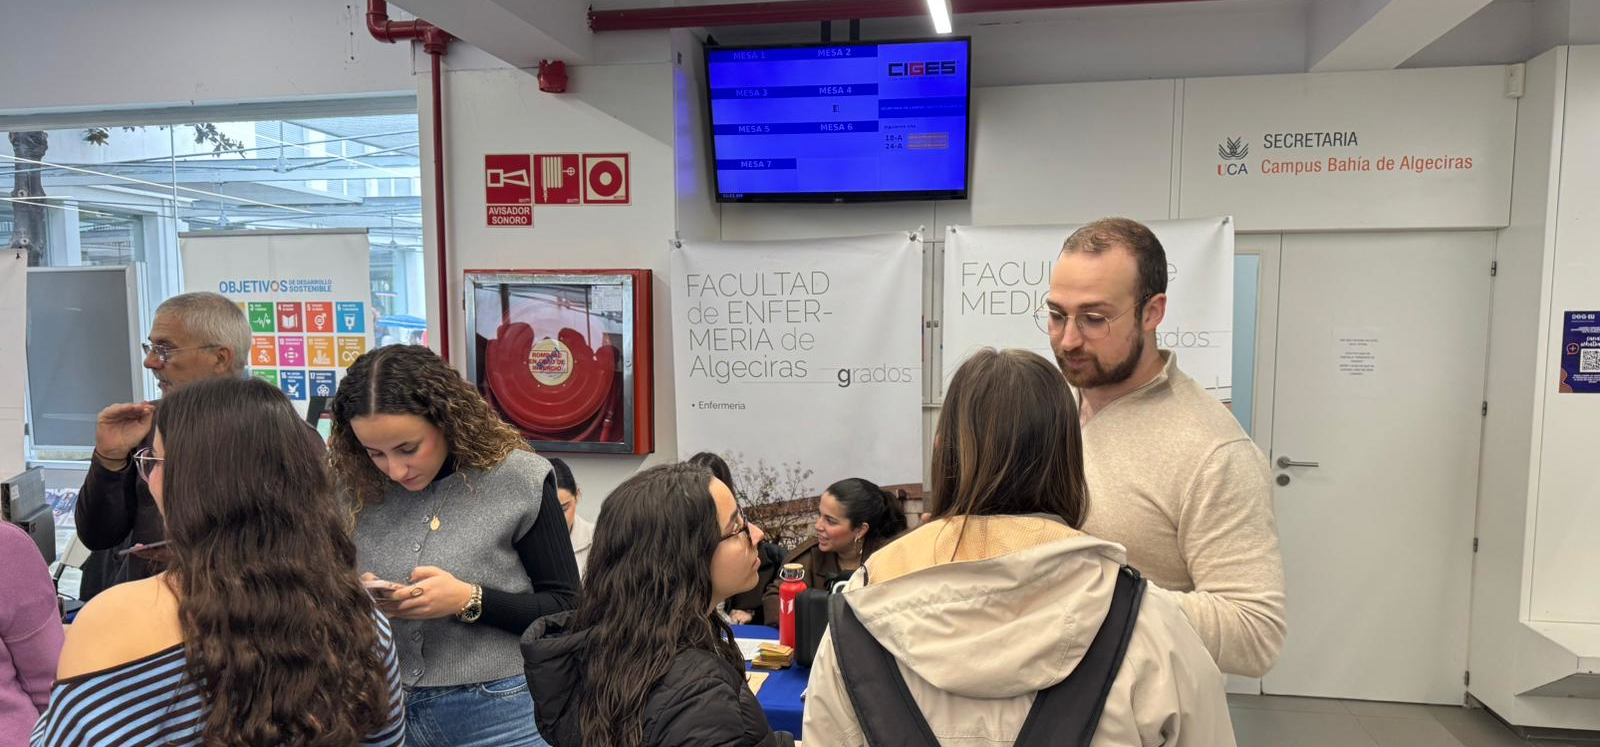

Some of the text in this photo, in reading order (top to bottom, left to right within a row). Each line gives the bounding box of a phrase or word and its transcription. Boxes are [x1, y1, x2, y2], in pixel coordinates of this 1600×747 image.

[733, 51, 759, 60] MESA
[817, 48, 851, 57] MESA 2
[888, 61, 956, 77] CIGES
[735, 88, 768, 97] MESA 3
[819, 86, 852, 95] MESA 4
[738, 125, 763, 133] MESA
[820, 123, 853, 131] MESA 6
[1263, 132, 1358, 149] SECRETARIA
[741, 160, 772, 168] MESA 7
[1217, 163, 1248, 176] UCA
[1261, 154, 1473, 176] Campus Bahía de Algeciras
[488, 206, 530, 216] AVISADOR
[492, 216, 528, 225] SONORO
[219, 280, 288, 293] OBJETIVOS
[686, 270, 830, 297] FACULTAD
[687, 299, 833, 324] de ENFER-
[689, 322, 815, 351] MERÍA de
[689, 354, 808, 385] Algeciras
[837, 363, 913, 388] grados
